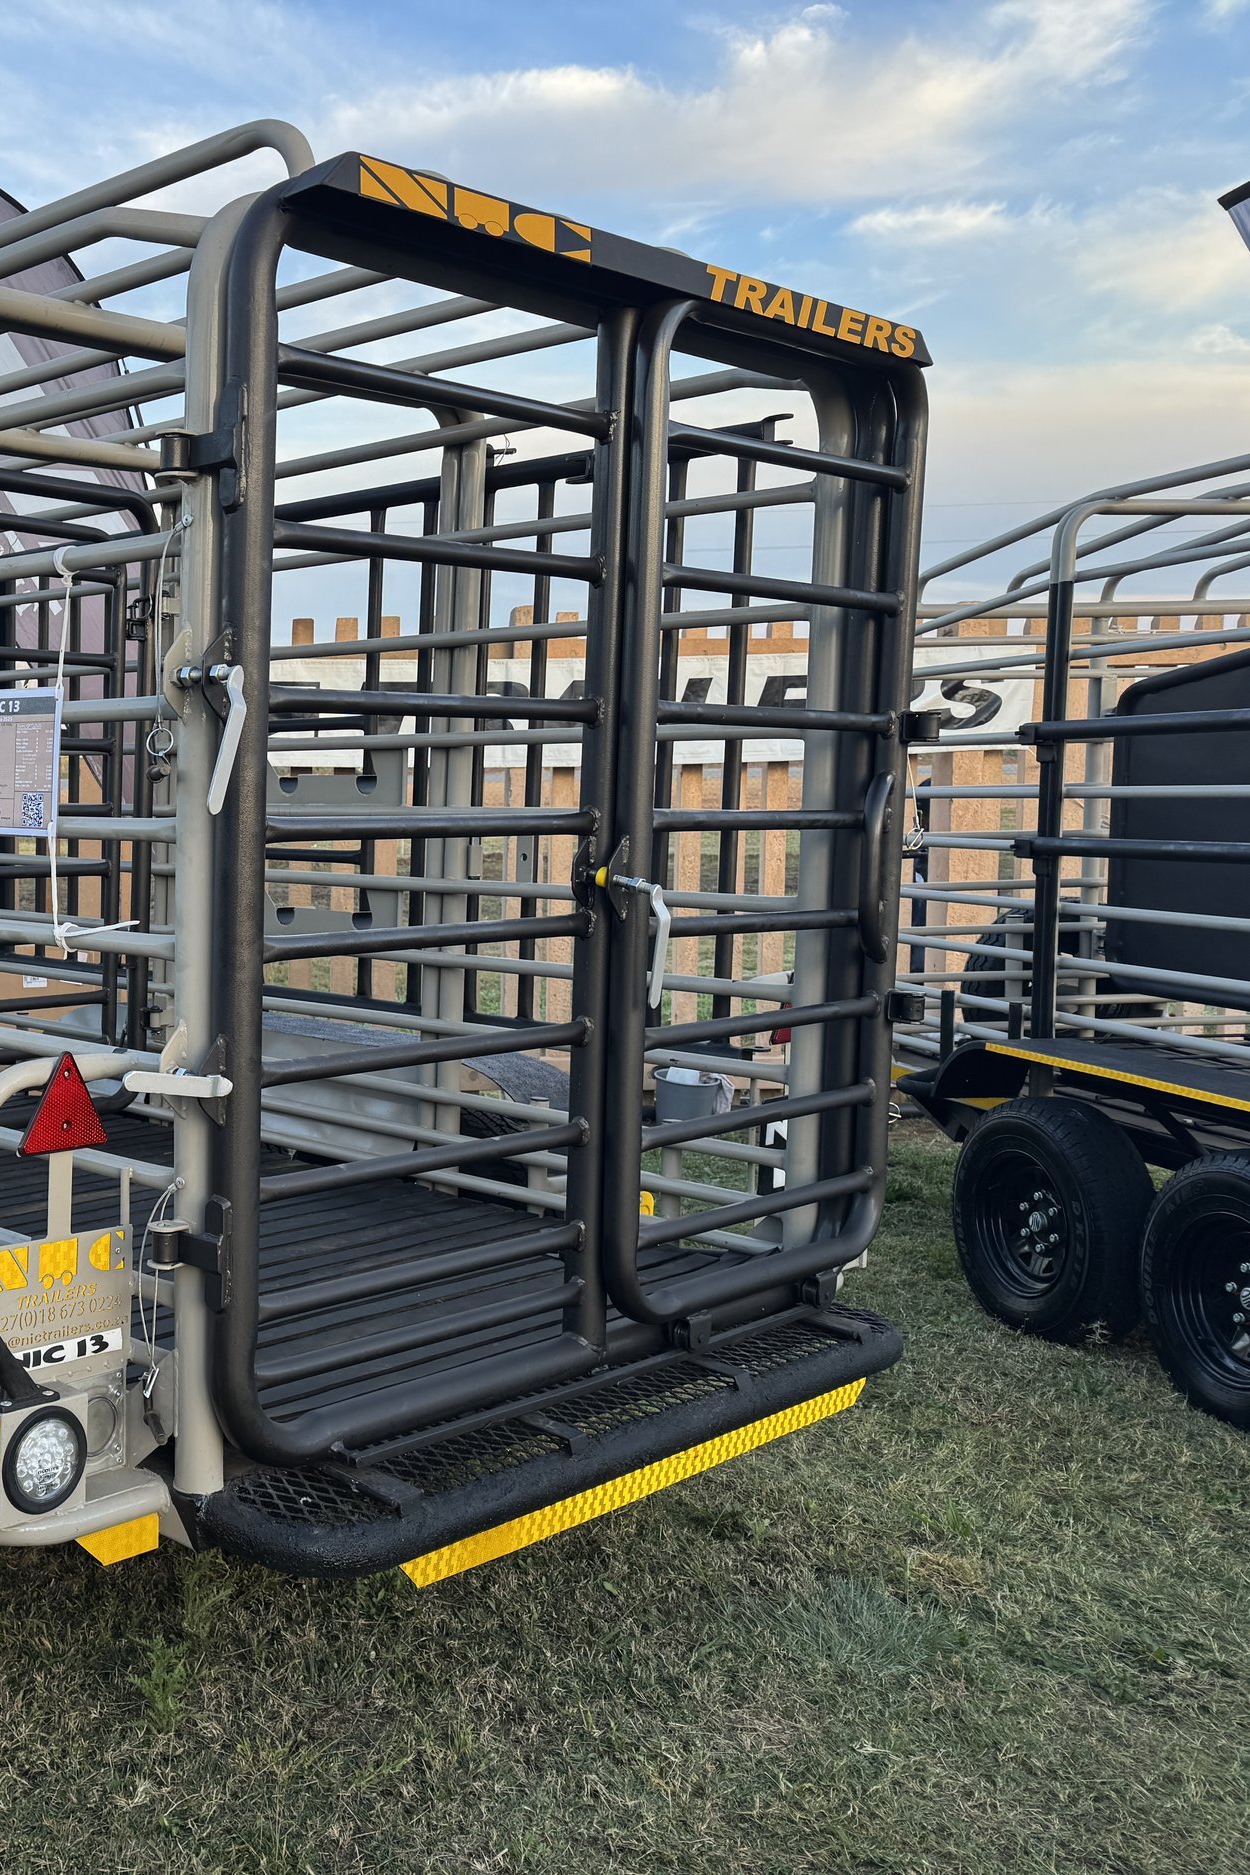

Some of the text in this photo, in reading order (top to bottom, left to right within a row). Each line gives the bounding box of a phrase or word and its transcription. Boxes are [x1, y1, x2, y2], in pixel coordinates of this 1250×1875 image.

[706, 264, 917, 358] TRAILERS
[9, 700, 20, 713] 13
[17, 1283, 98, 1310] TRAILERS
[60, 1300, 85, 1320] 673
[76, 1334, 110, 1358] 13
